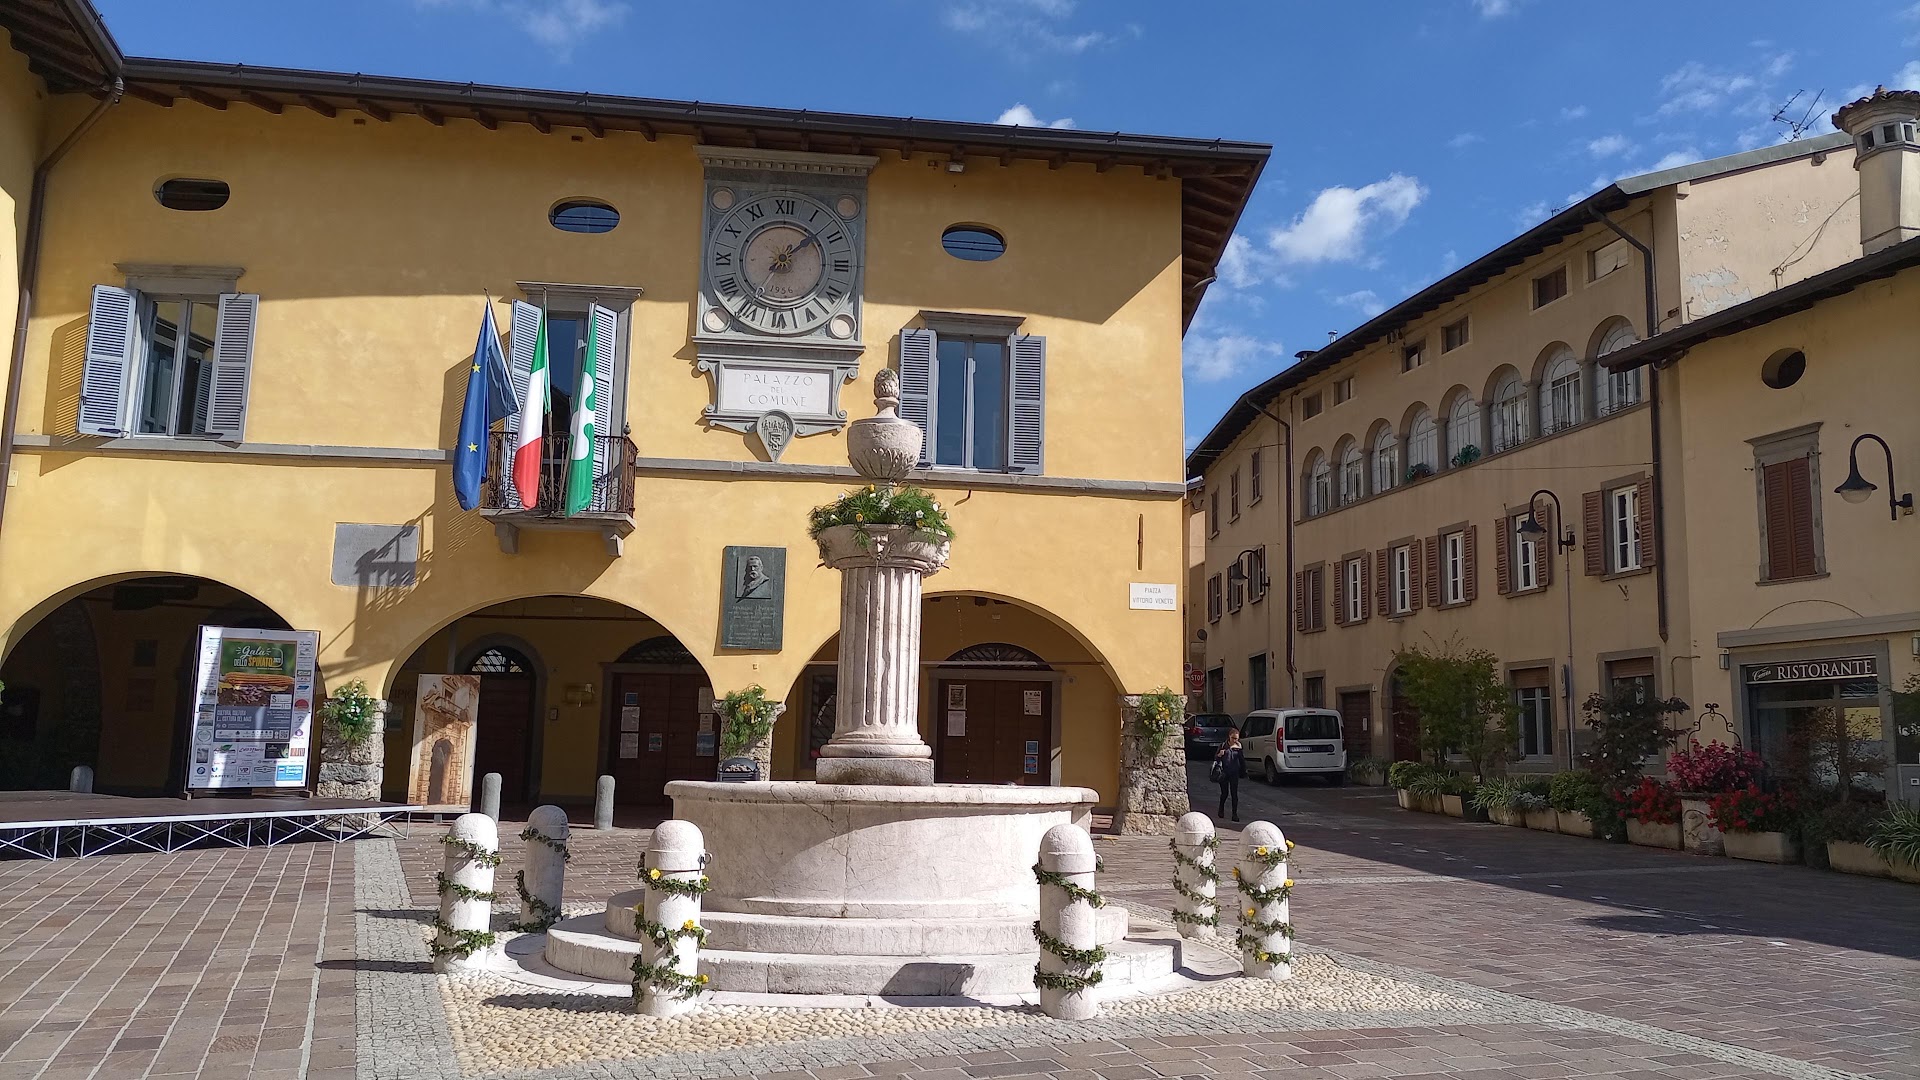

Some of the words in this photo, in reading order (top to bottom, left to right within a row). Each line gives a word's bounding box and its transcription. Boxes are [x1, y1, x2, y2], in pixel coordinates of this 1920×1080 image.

[746, 204, 764, 221] XI
[775, 199, 795, 215] XII
[808, 209, 819, 222] I
[725, 224, 741, 239] X
[827, 230, 843, 244] II
[716, 252, 732, 266] IX
[834, 259, 849, 272] III
[720, 277, 740, 302] VIII
[769, 285, 794, 294] 1956
[826, 286, 842, 305] IV
[744, 373, 814, 386] PALAZZO
[748, 394, 808, 407] COMUNE
[247, 657, 273, 667] SPINATO
[1777, 659, 1873, 680] RISTORANTE
[1190, 674, 1204, 682] STOP
